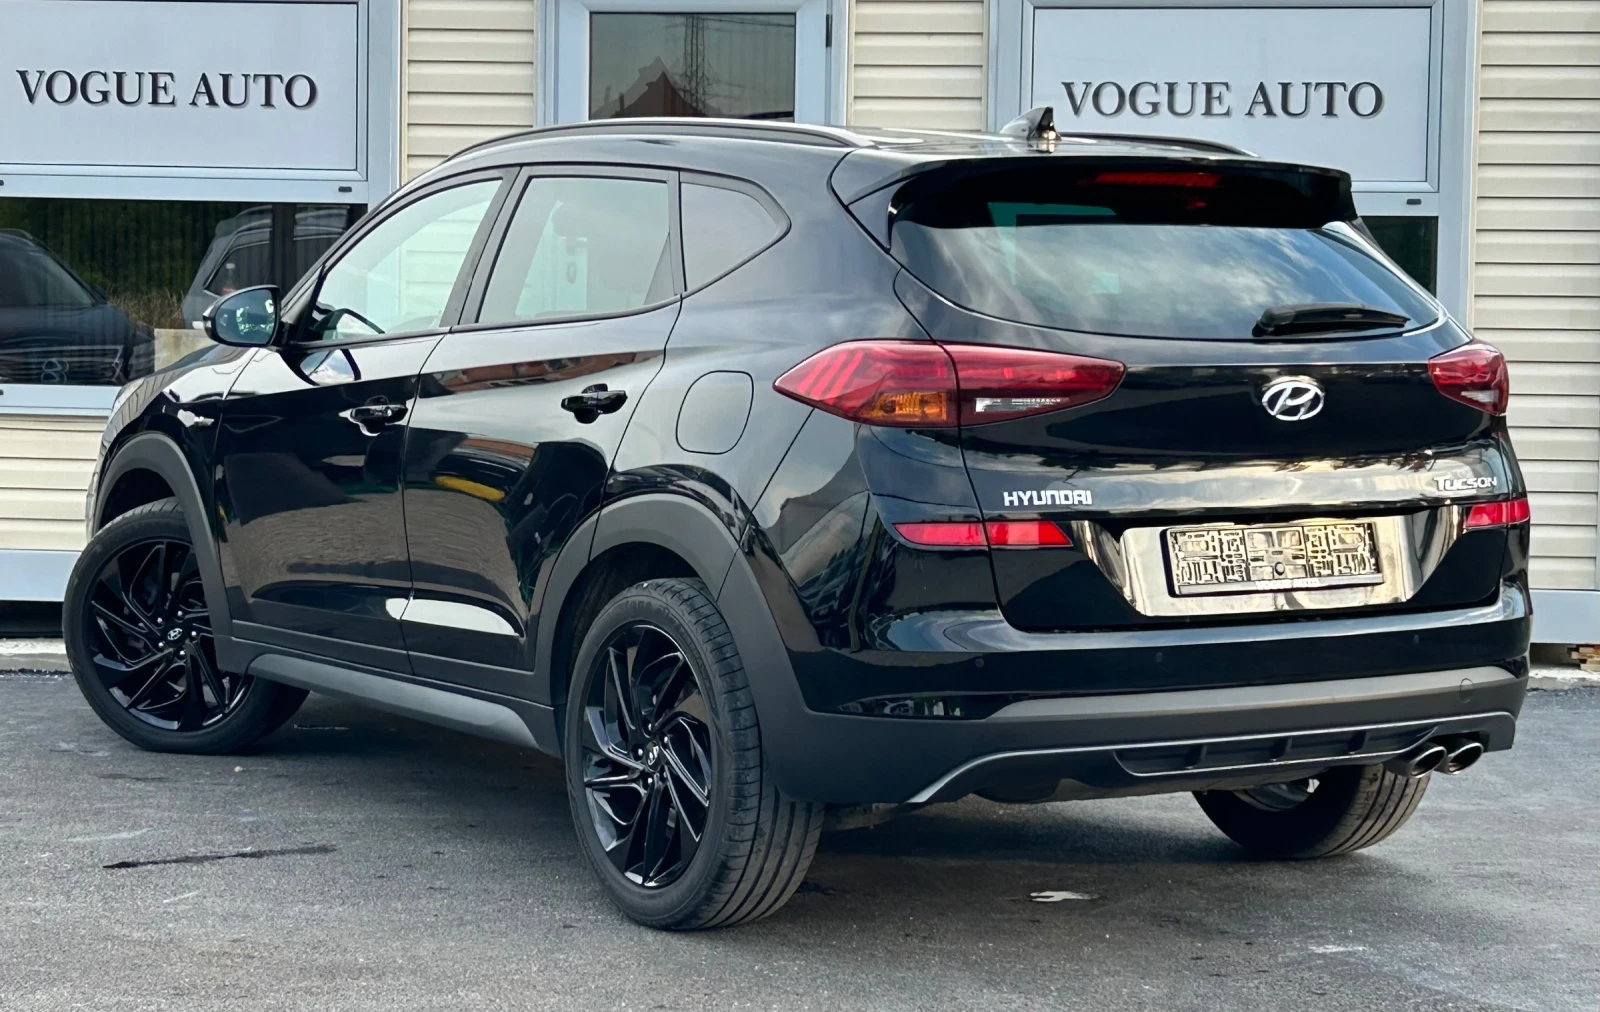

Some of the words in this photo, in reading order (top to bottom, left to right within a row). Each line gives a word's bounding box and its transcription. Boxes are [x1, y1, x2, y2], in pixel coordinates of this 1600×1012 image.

[16, 70, 176, 105] VOGUE
[189, 72, 318, 109] AUTO
[1061, 81, 1231, 116] VOGUE
[1245, 81, 1383, 117] AUTO
[1433, 476, 1498, 491] TUCSON
[1003, 489, 1092, 506] HYUNDAI
